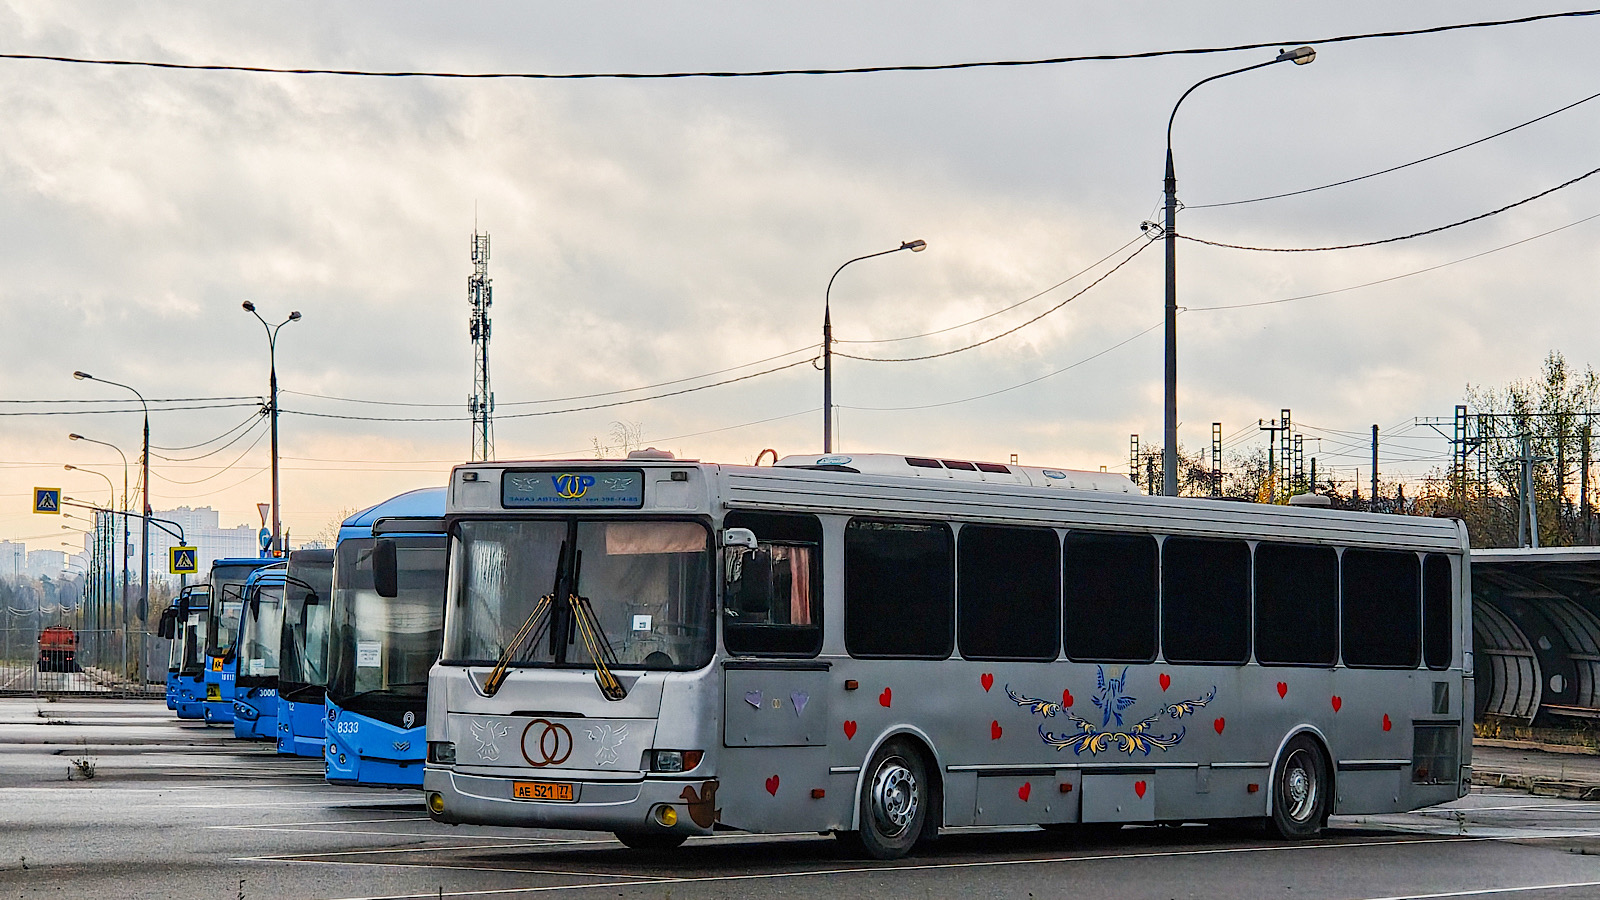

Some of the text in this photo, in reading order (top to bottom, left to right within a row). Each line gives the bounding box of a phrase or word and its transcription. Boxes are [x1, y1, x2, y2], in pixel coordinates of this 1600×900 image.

[551, 475, 596, 494] VIP
[259, 689, 276, 697] 3000
[337, 721, 359, 733] 8333
[534, 784, 553, 798] 521
[559, 785, 569, 795] 77
